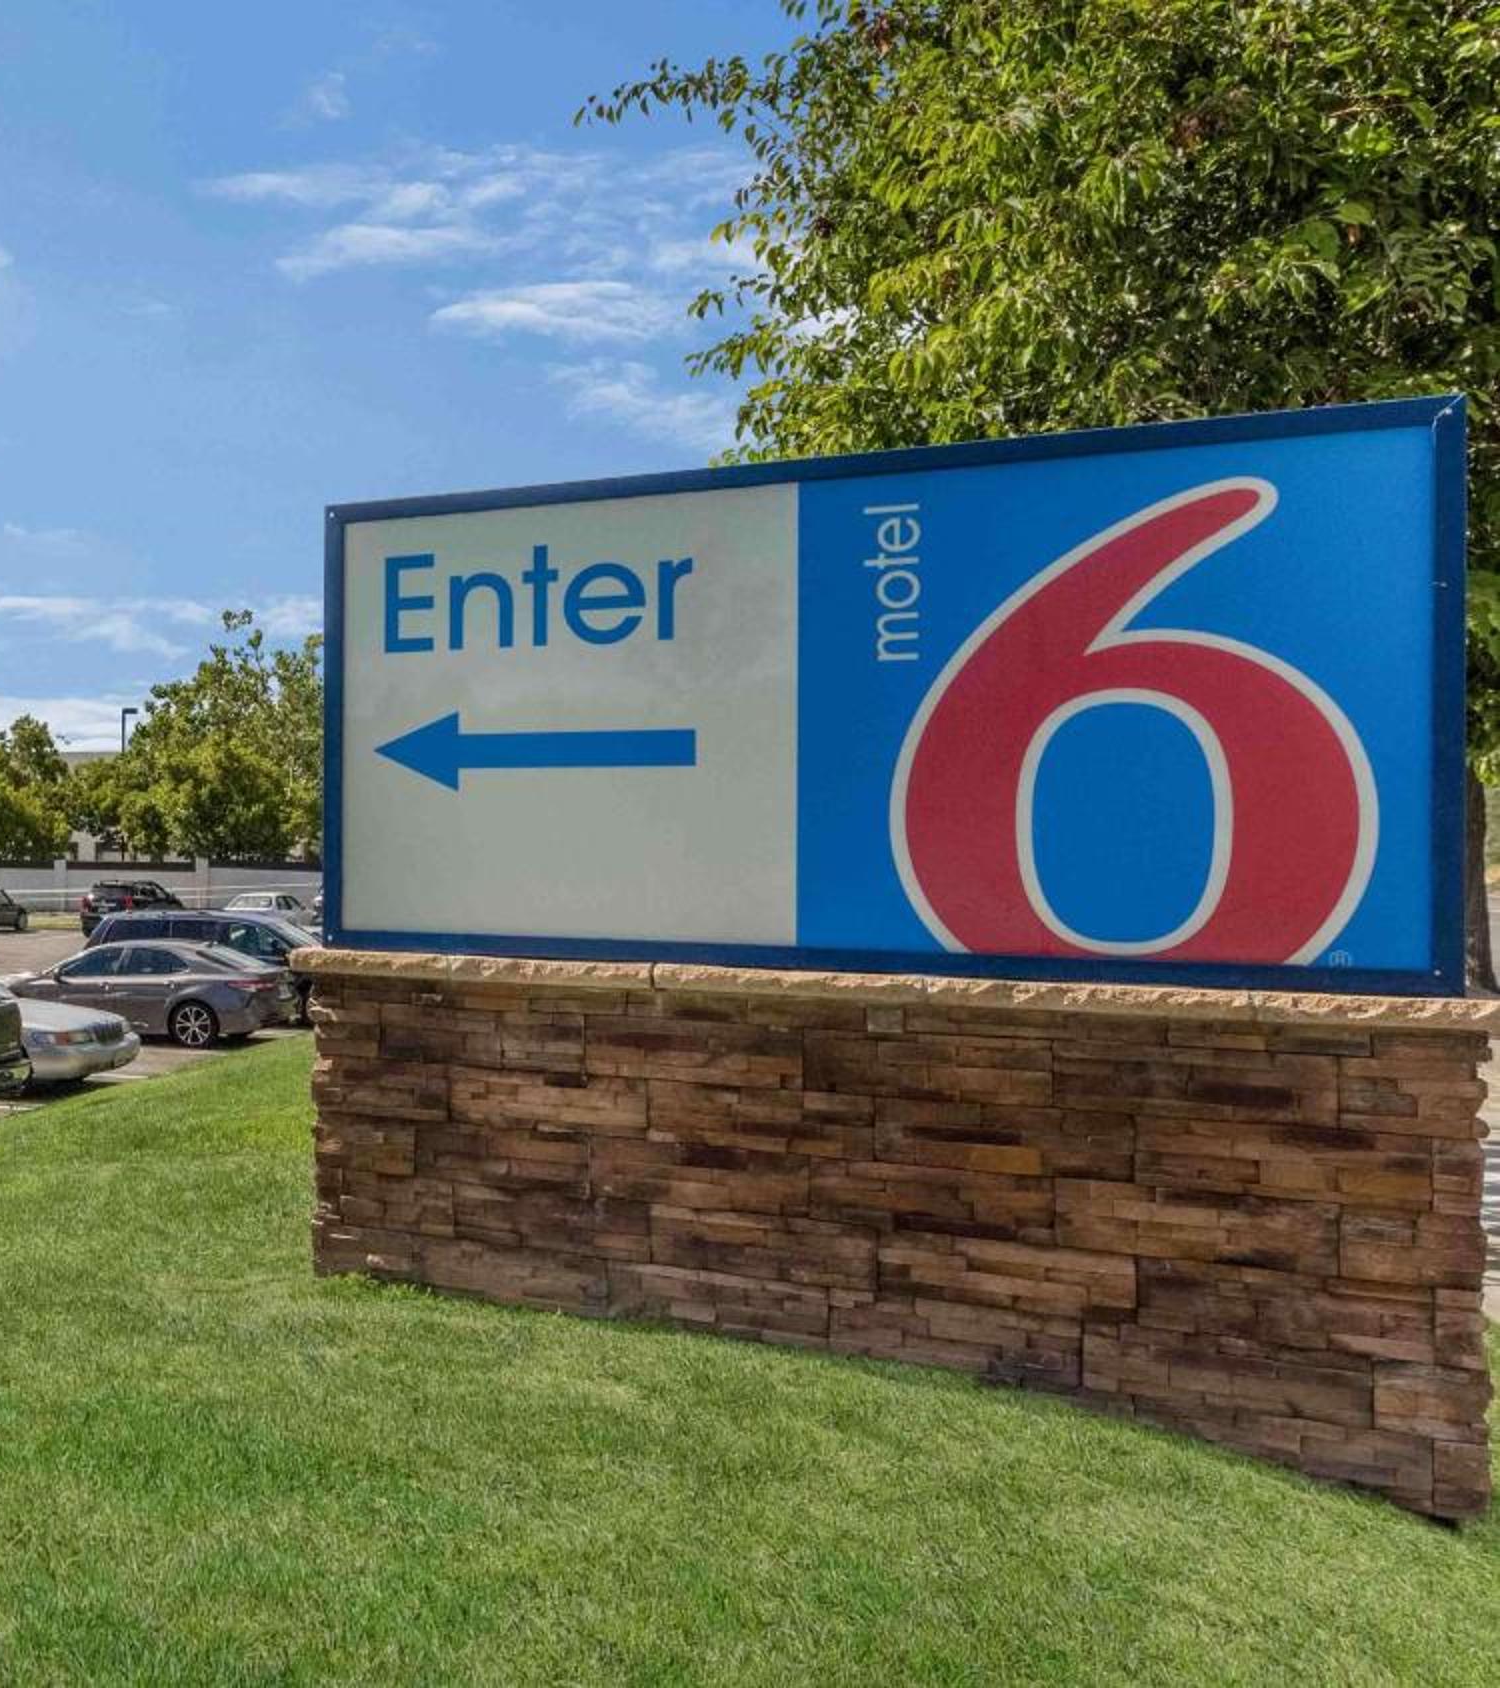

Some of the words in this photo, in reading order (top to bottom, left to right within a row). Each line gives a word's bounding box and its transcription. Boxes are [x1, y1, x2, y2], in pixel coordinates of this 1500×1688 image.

[382, 543, 694, 655] Enter
[865, 503, 920, 661] motel
[889, 476, 1379, 965] 6
